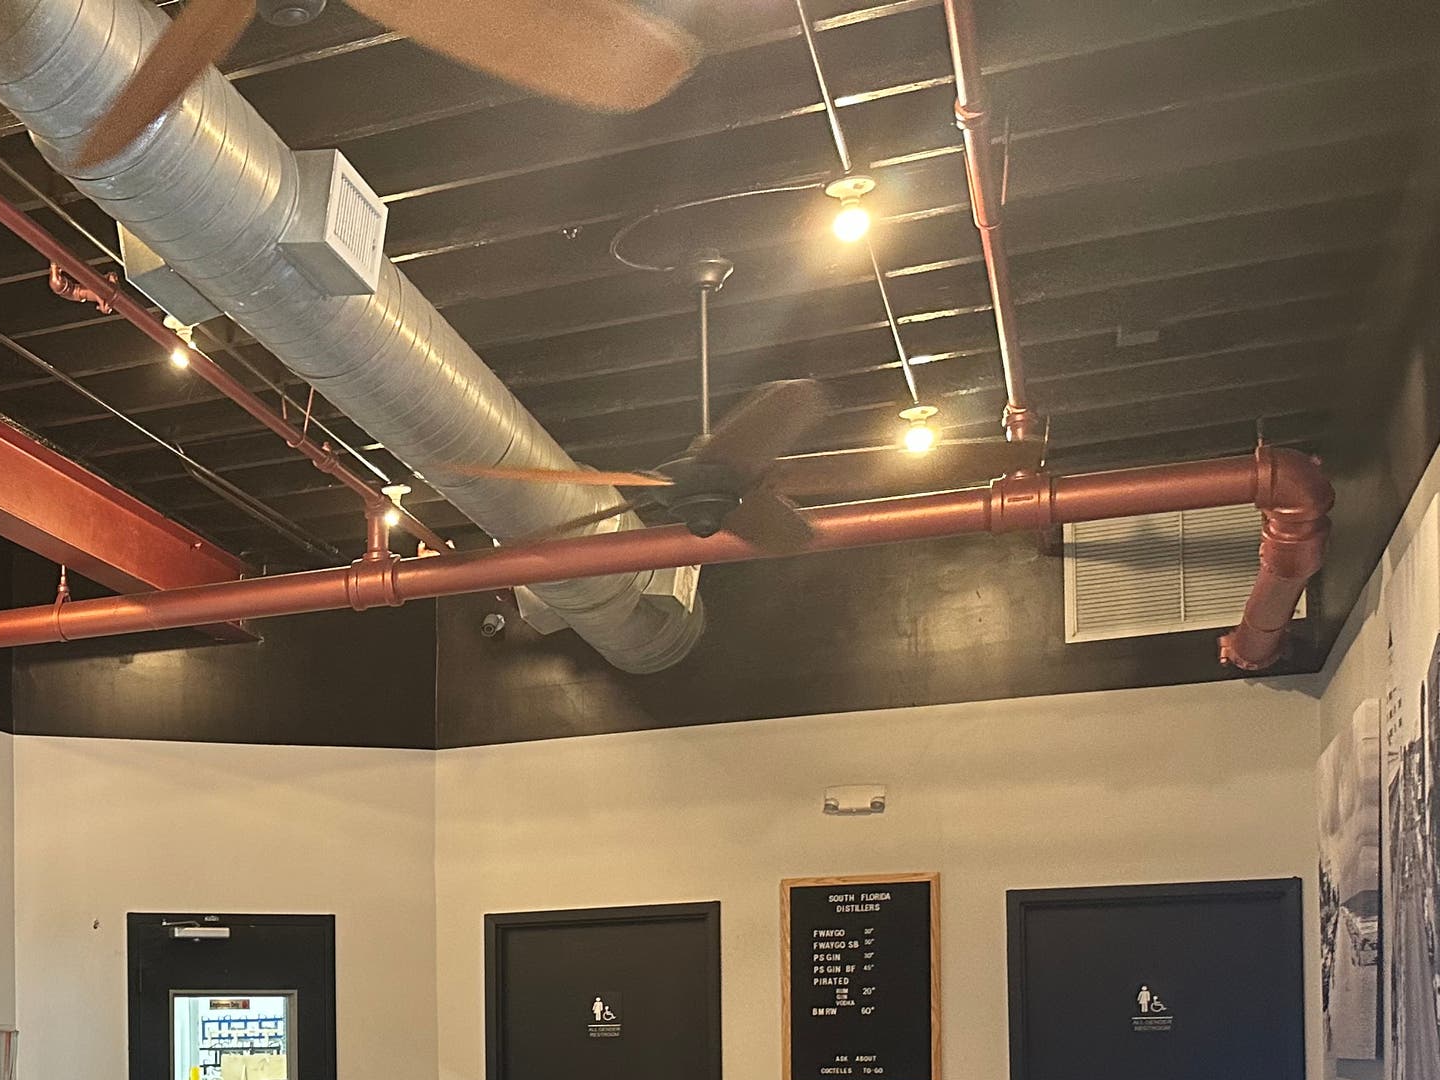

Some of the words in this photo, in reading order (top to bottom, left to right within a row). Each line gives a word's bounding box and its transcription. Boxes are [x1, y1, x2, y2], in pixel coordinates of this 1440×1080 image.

[828, 893, 855, 903] SOUTH
[860, 892, 891, 902] FLORIDA
[836, 903, 880, 913] DISTILLERS
[813, 929, 845, 938] FWAYGO
[813, 941, 846, 950] FWAYGO
[847, 940, 860, 949] SB
[813, 954, 825, 962] PS
[825, 953, 841, 961] GIN
[813, 965, 825, 973] PS
[826, 965, 841, 973] GIN
[813, 977, 849, 986] PIRATED
